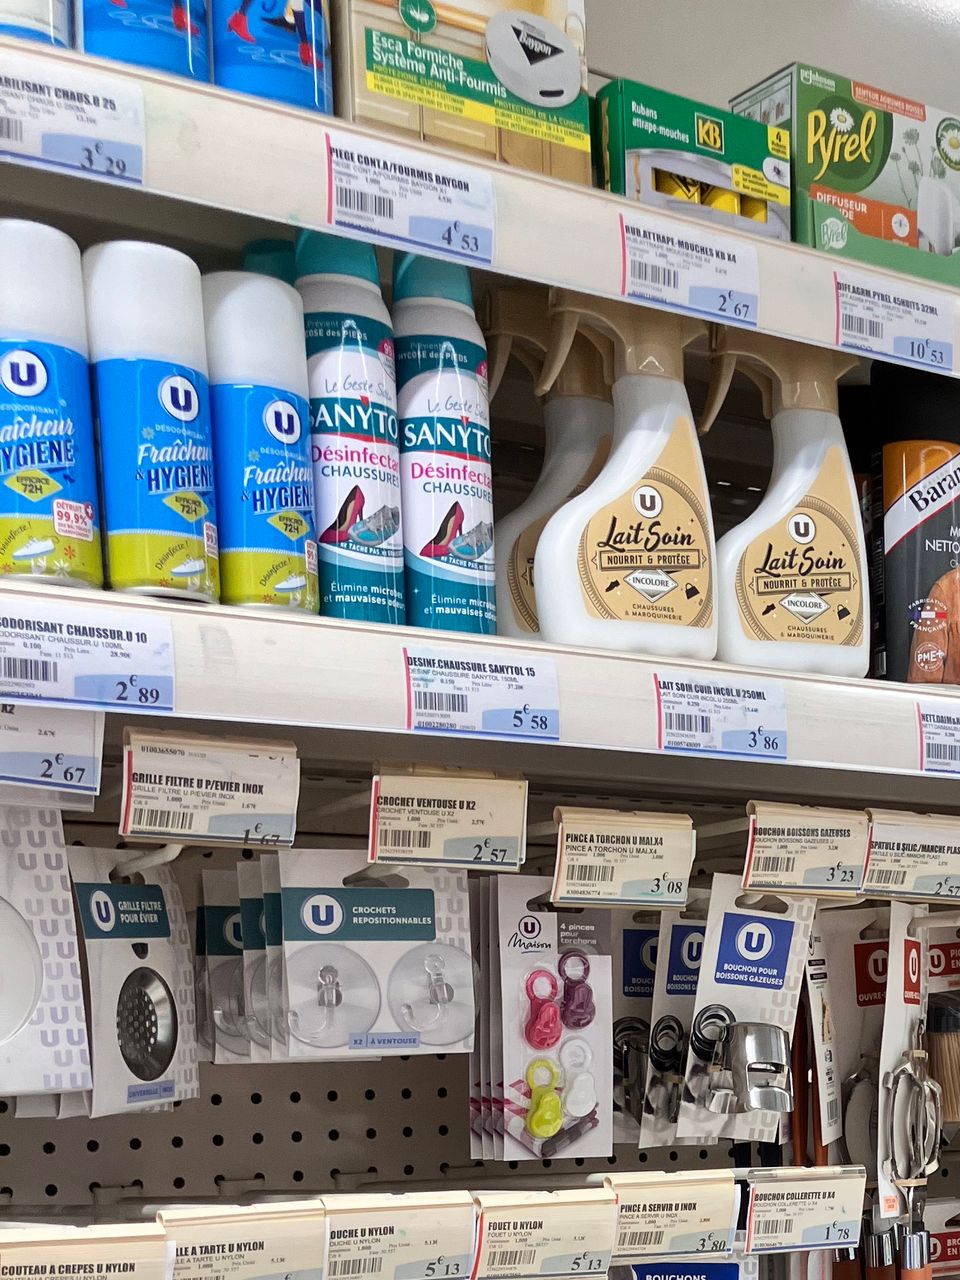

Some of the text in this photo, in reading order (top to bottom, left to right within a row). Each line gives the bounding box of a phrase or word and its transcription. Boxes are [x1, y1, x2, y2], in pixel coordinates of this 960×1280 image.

[372, 31, 464, 70] Esca Formiche
[518, 31, 551, 57] Baygon
[373, 46, 507, 98] Système Anti-Fourmis
[631, 102, 658, 120] Rubans
[631, 117, 689, 144] attrape-mouches
[698, 119, 722, 148] KB
[807, 107, 876, 180] Pyrel
[816, 190, 868, 215] DIFFUSEUR
[598, 518, 695, 552] Lait Soin
[607, 553, 691, 565] NOURRIT PROTÈGE
[754, 543, 845, 575] Lait Soin
[632, 576, 670, 588] INCOLORE
[763, 578, 799, 590] NOURRIT
[632, 603, 674, 613] CHAUSSURES
[788, 600, 823, 610] INCOLORE
[631, 609, 682, 622] MAROQUINERIE
[488, 662, 524, 676] SANYTOL
[659, 680, 674, 691] LAIT
[132, 772, 163, 787] GRILLE
[165, 775, 195, 788] FILTRE
[239, 782, 263, 795] INOX
[377, 795, 457, 810] CROCHET VENTOUSE
[566, 833, 631, 845] PINCE TORCHON
[311, 904, 336, 925] U
[352, 906, 396, 915] CROCHETS
[352, 916, 432, 925] REPOSITIONNABLES
[568, 923, 595, 932] pinces
[508, 932, 551, 949] Maison
[745, 932, 765, 952] U
[724, 963, 778, 976] BOUCHON POUR
[716, 972, 783, 986] BOISSONS GAZEUSES
[376, 1037, 417, 1047] VENTOUSE
[755, 1192, 783, 1202] BOUCHON
[620, 1202, 697, 1213] PINCE SERVIR INOX
[488, 1220, 543, 1231] FOUET NYLON
[202, 1241, 265, 1254] TARTE NYLON
[1, 1262, 135, 1276] COUTEAU CREPES NYLON
